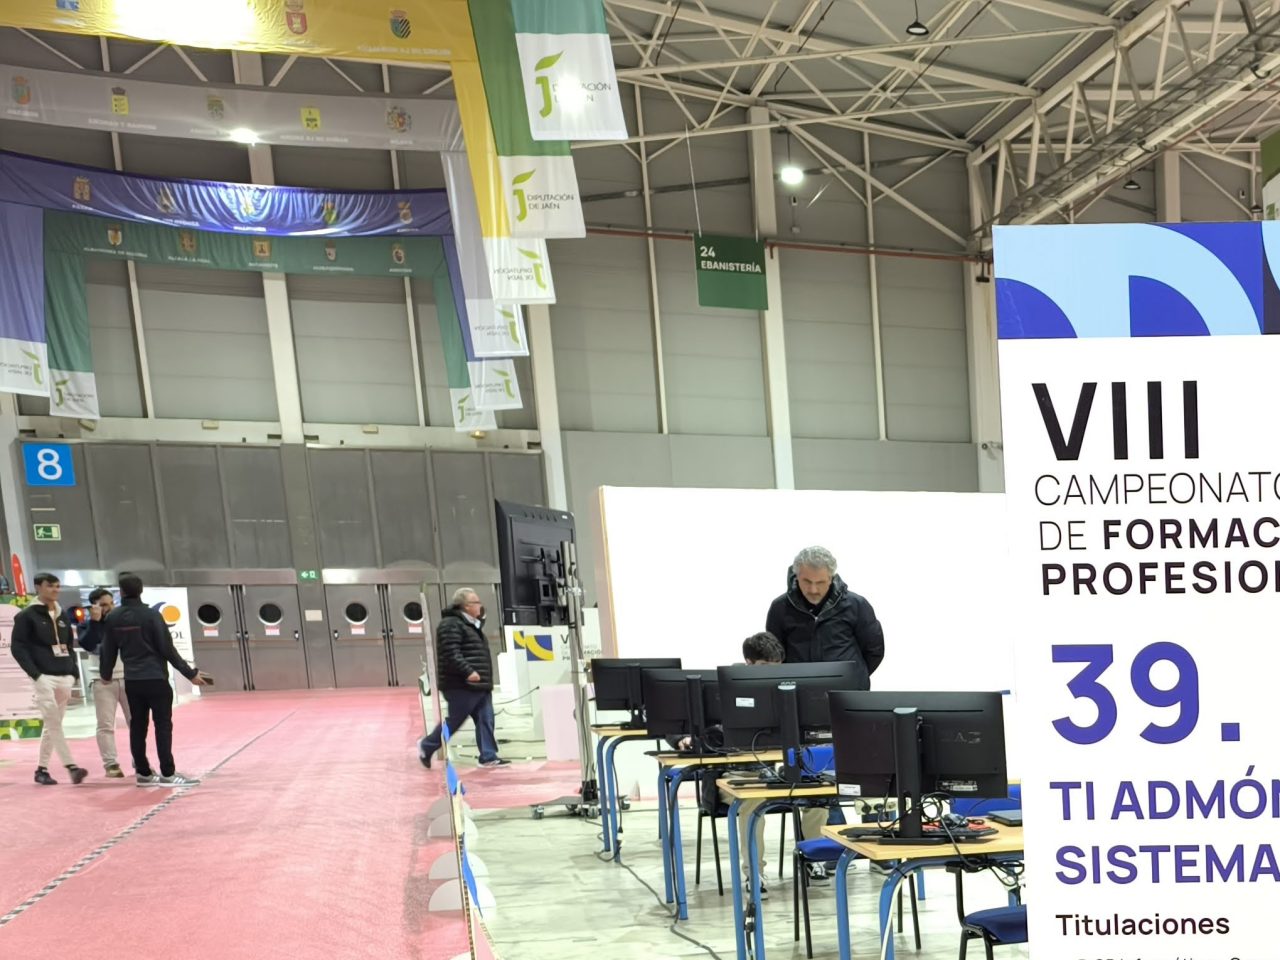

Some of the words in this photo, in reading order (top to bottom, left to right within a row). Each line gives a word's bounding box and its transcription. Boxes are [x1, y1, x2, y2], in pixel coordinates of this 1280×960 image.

[700, 246, 715, 257] 24
[701, 261, 762, 272] EBANISTERÍA
[1031, 380, 1199, 461] VIII
[37, 448, 62, 480] 8
[1039, 520, 1087, 551] DE
[1051, 641, 1240, 745] 39.
[1049, 781, 1095, 821] TI
[1055, 913, 1230, 936] Titulaciones
